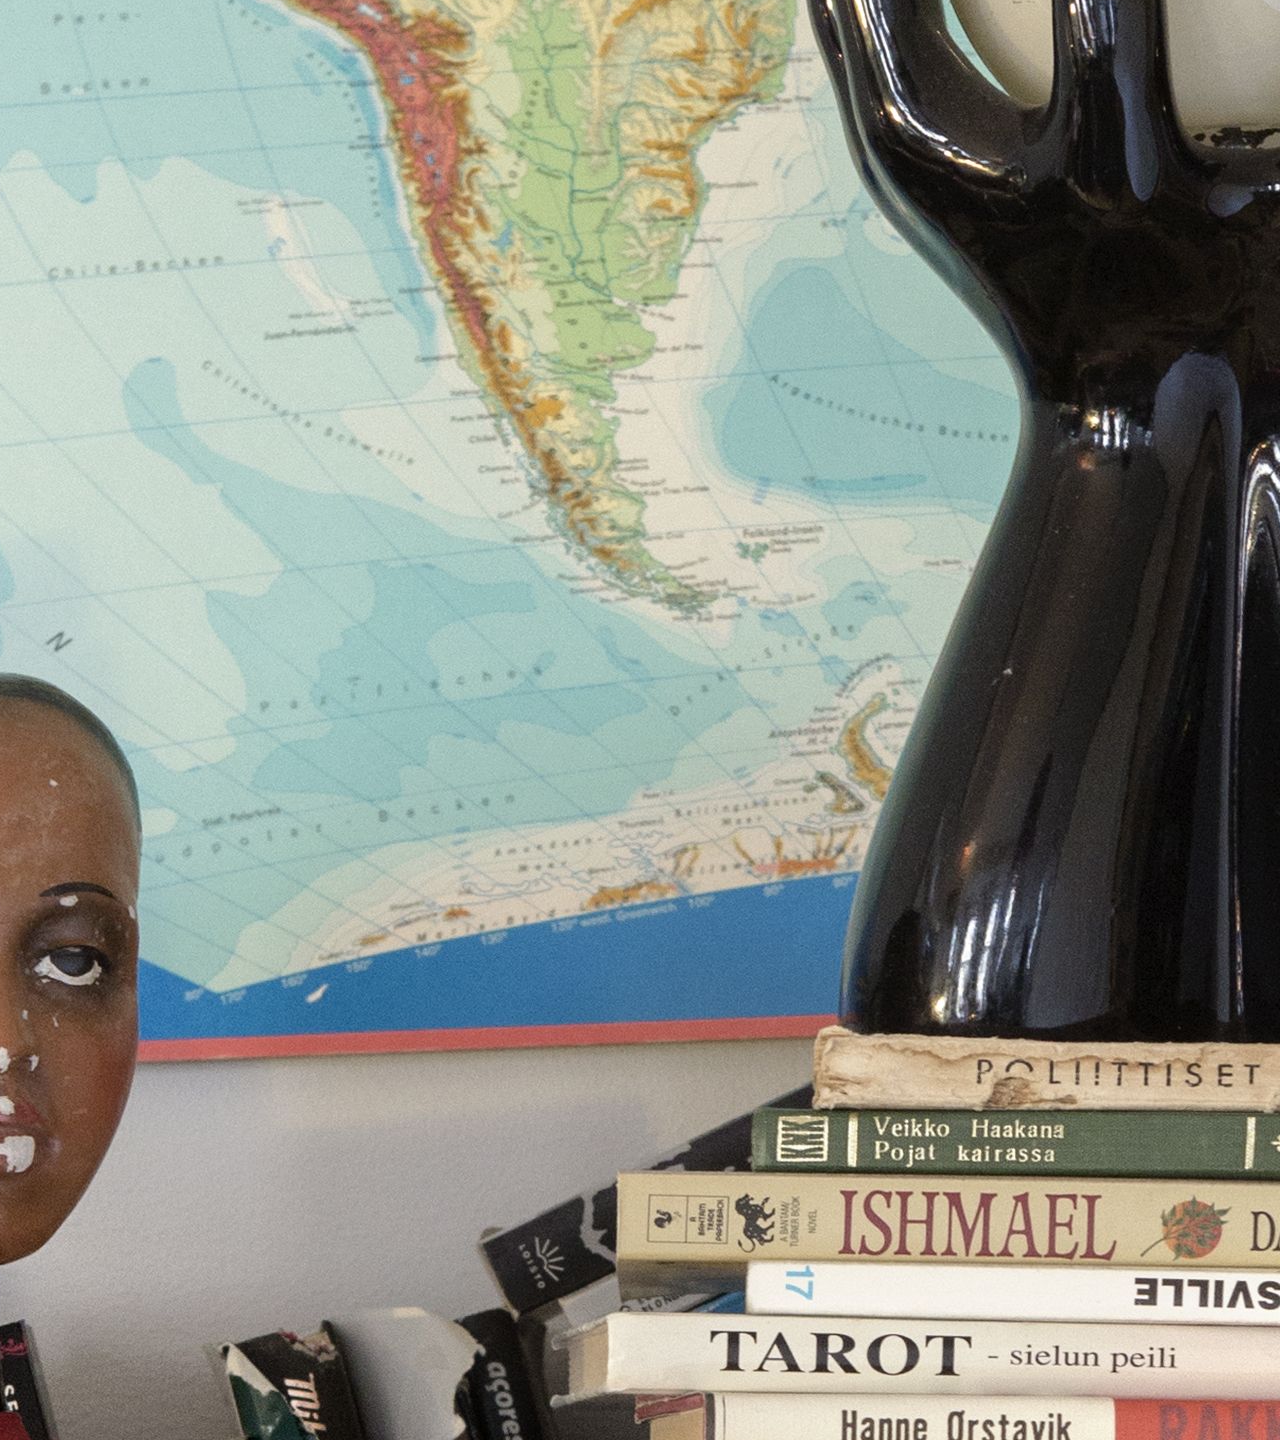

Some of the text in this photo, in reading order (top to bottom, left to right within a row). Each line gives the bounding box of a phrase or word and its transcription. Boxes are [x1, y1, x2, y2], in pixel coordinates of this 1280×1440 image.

[873, 1116, 1066, 1140] Veikko Haakana
[874, 1141, 1057, 1169] Pojat kairassa
[807, 1208, 818, 1235] NOVEL
[837, 1189, 1118, 1260] ISHMAEL
[784, 1265, 816, 1301] 17
[710, 1330, 1178, 1378] TAROT sielun peili
